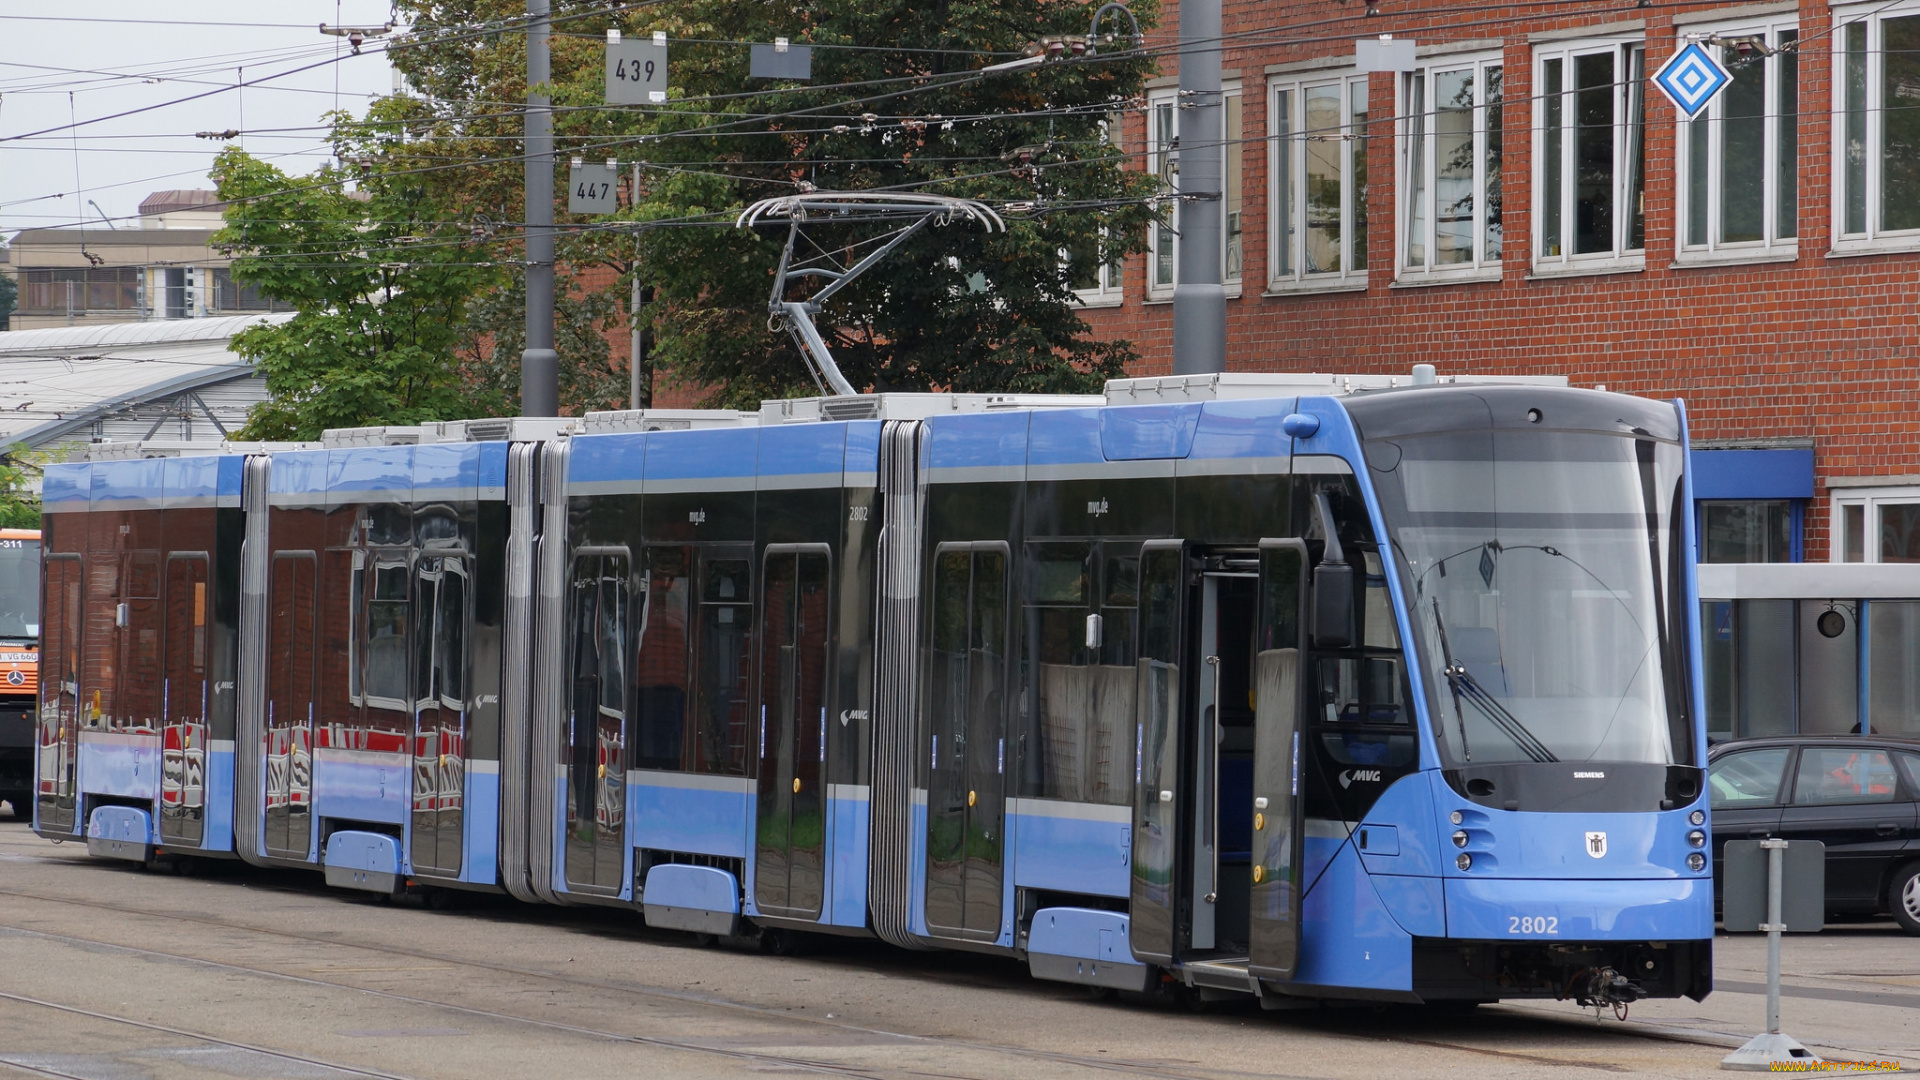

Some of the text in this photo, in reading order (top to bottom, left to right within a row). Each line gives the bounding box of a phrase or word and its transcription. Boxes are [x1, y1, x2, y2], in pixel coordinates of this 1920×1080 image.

[616, 59, 655, 82] 439
[577, 182, 609, 200] 447
[850, 506, 868, 521] 2802
[1087, 497, 1108, 517] mvg.de
[849, 710, 867, 719] MVG
[1352, 770, 1380, 781] MVG
[1573, 771, 1604, 779] SIEMENS
[1509, 916, 1559, 934] 2802
